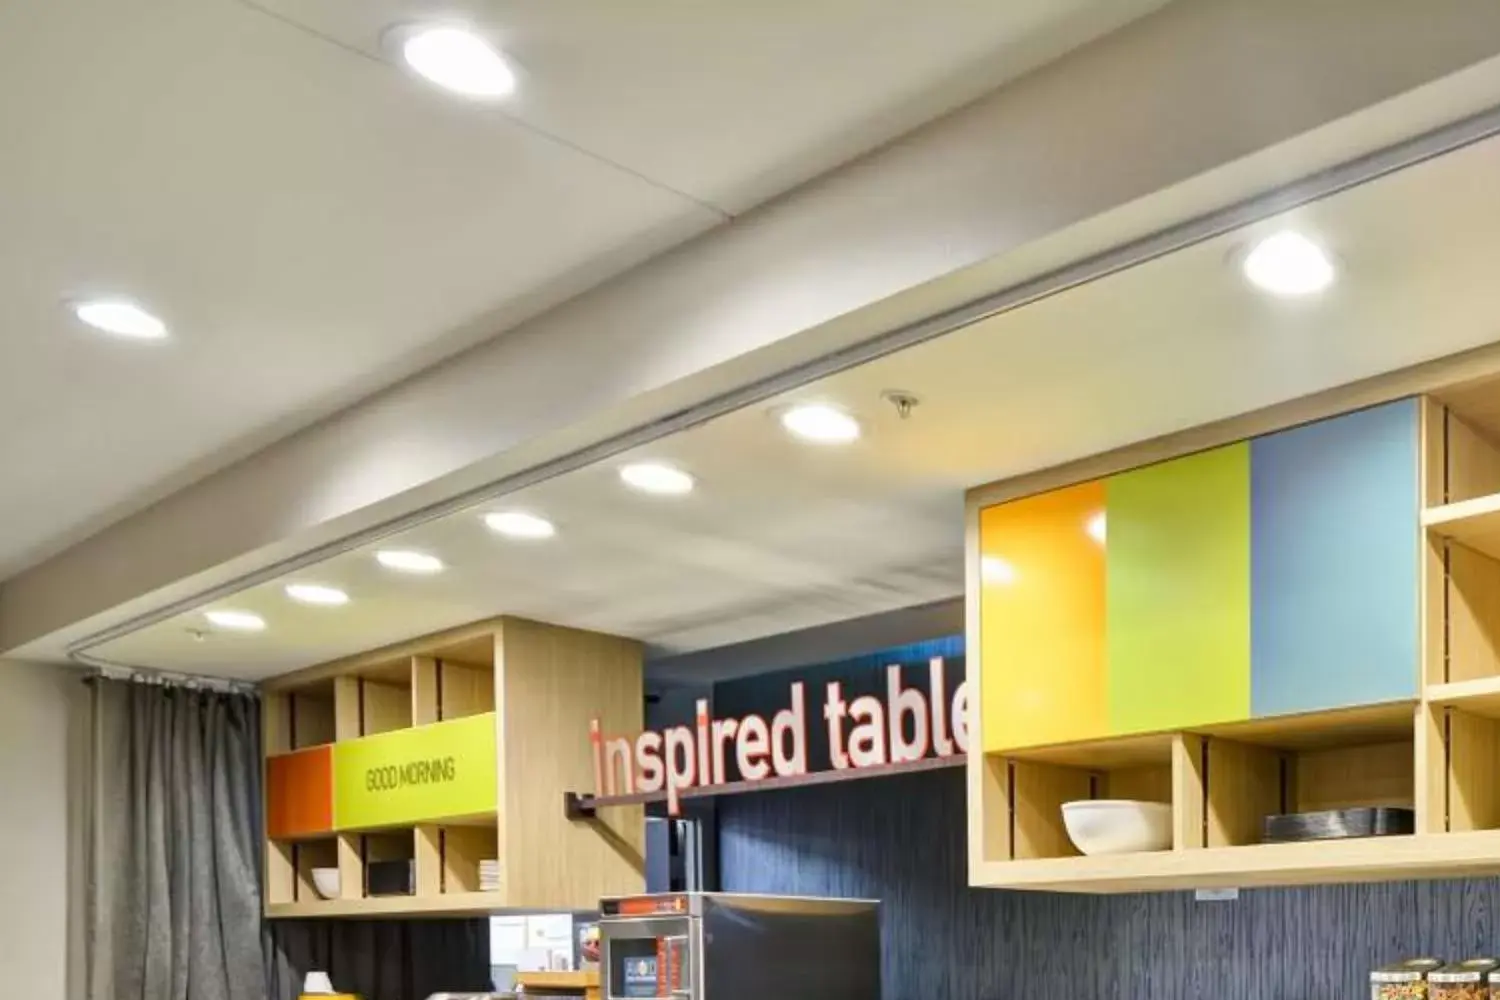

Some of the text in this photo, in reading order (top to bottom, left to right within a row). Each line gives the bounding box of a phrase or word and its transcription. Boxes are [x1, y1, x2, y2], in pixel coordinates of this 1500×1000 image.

[366, 756, 456, 793] GOOD MORNING
[590, 682, 808, 816] inspired
